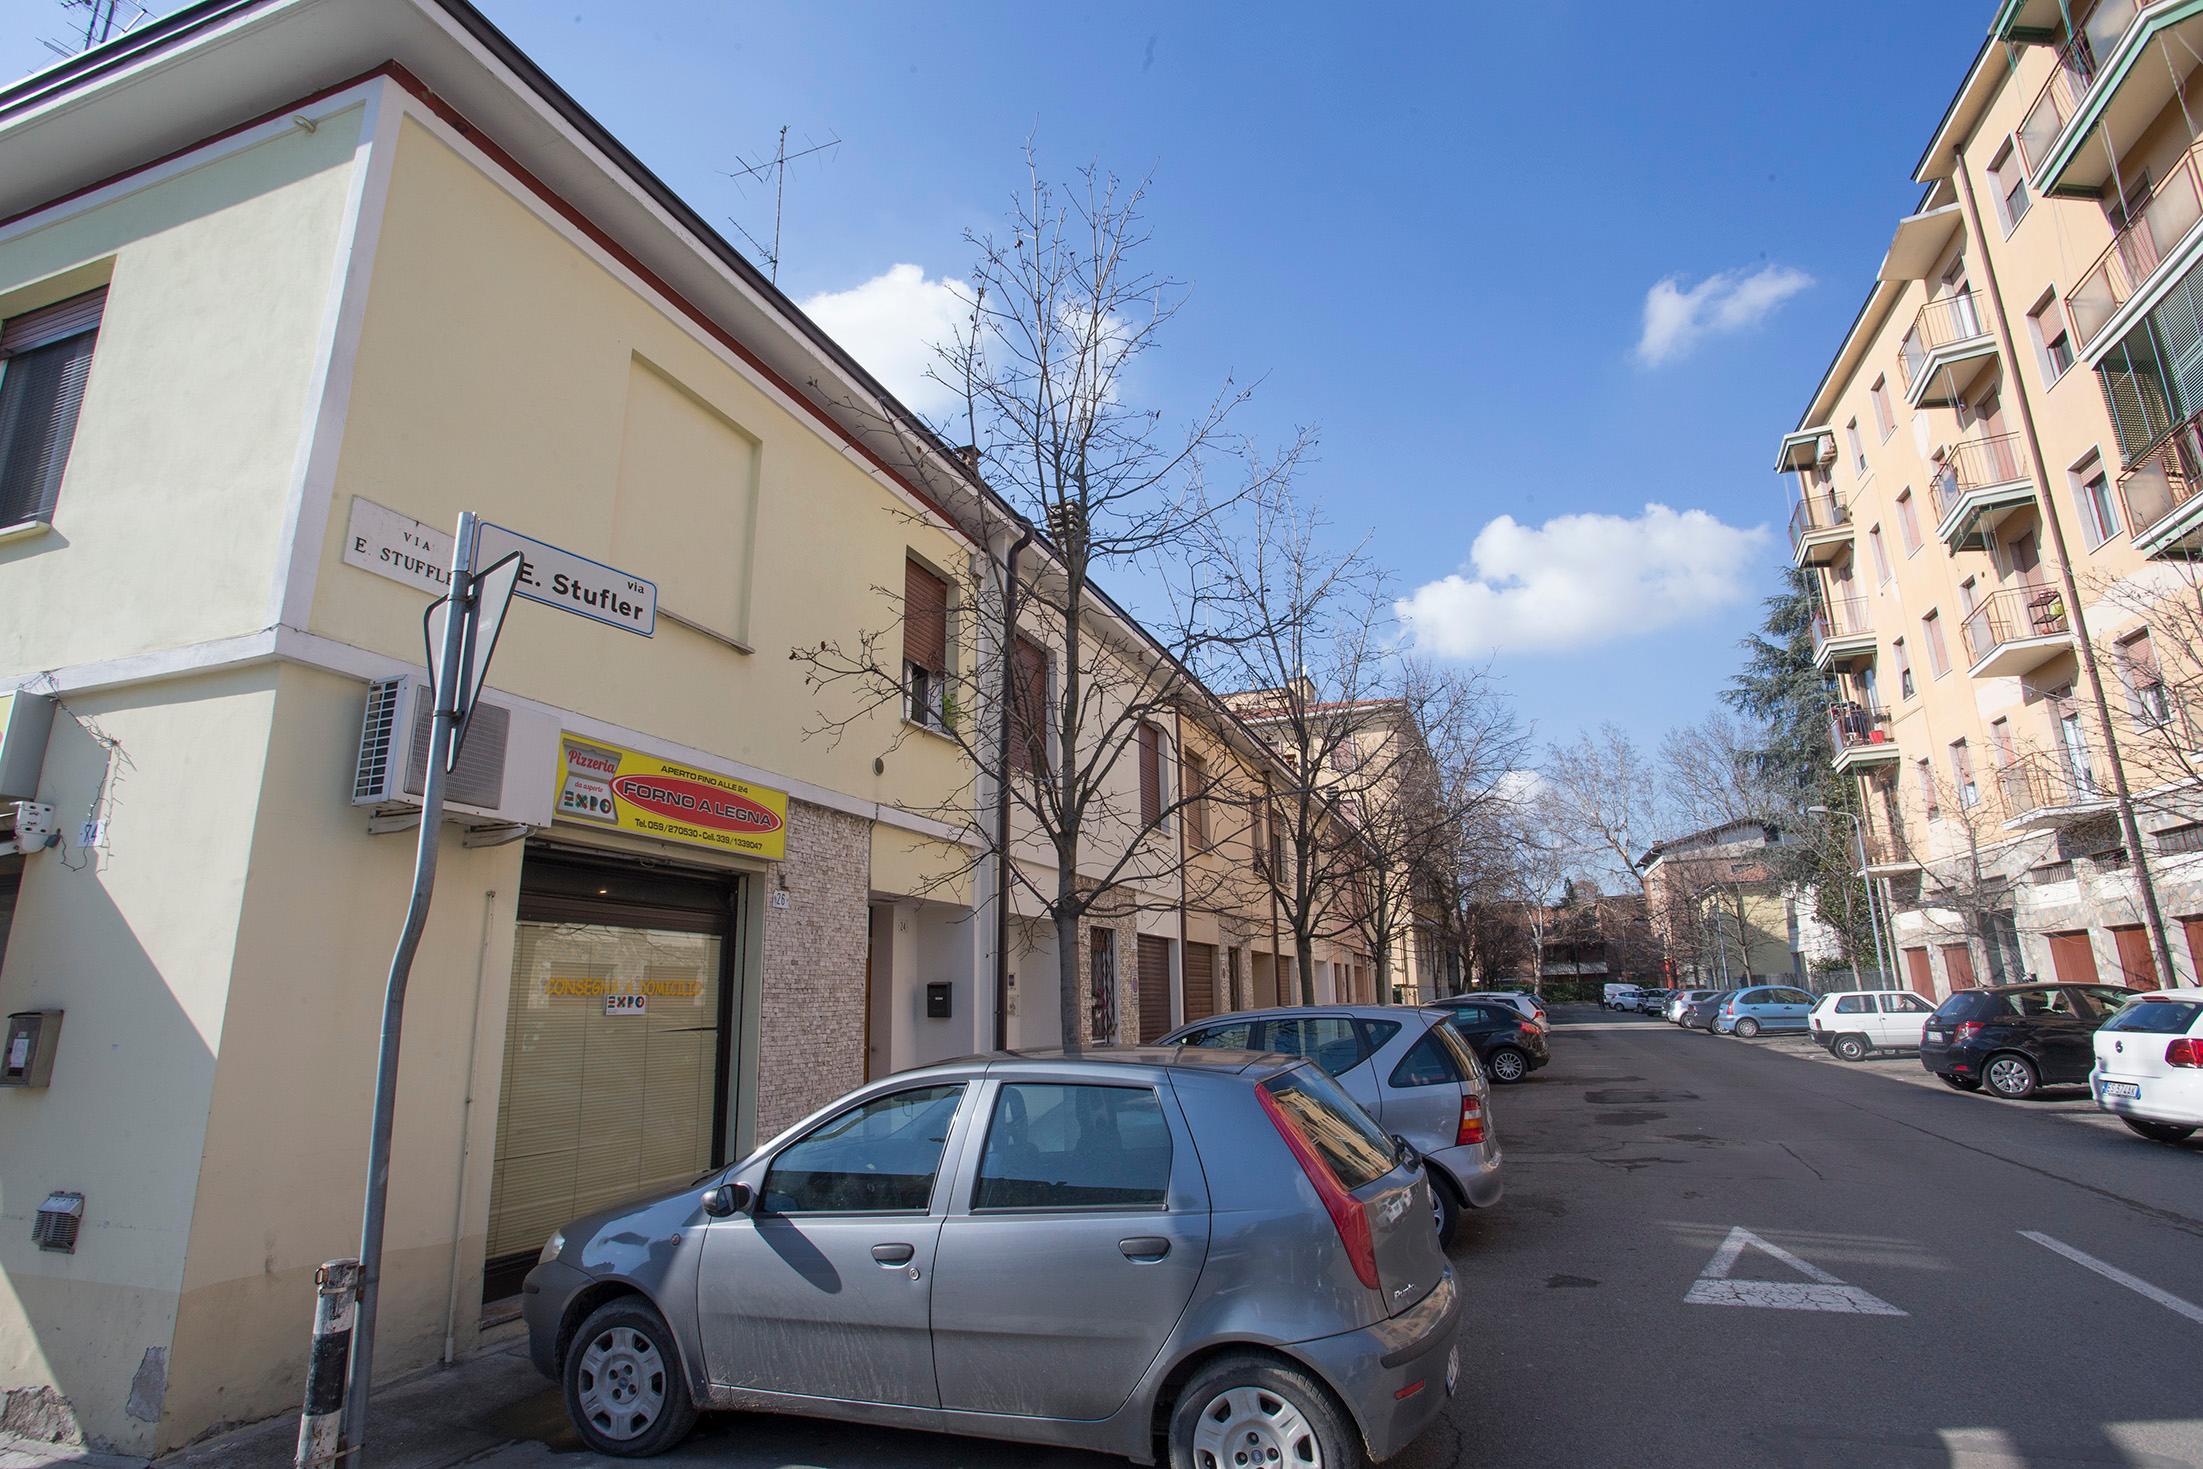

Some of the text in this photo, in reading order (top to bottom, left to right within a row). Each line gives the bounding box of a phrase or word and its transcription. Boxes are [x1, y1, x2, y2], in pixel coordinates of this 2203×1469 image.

[403, 531, 432, 551] VIA
[353, 536, 453, 585] E. STUFFLE
[519, 562, 643, 620] E. Stufler
[627, 581, 645, 594] via
[568, 749, 615, 774] Pizzeria
[660, 765, 748, 794] APERTO FINO ALLE 24
[563, 790, 612, 814] EXPO
[623, 781, 773, 828] FORNO A LEGNA
[634, 818, 647, 828] Tel.
[608, 996, 645, 1008] EXPO
